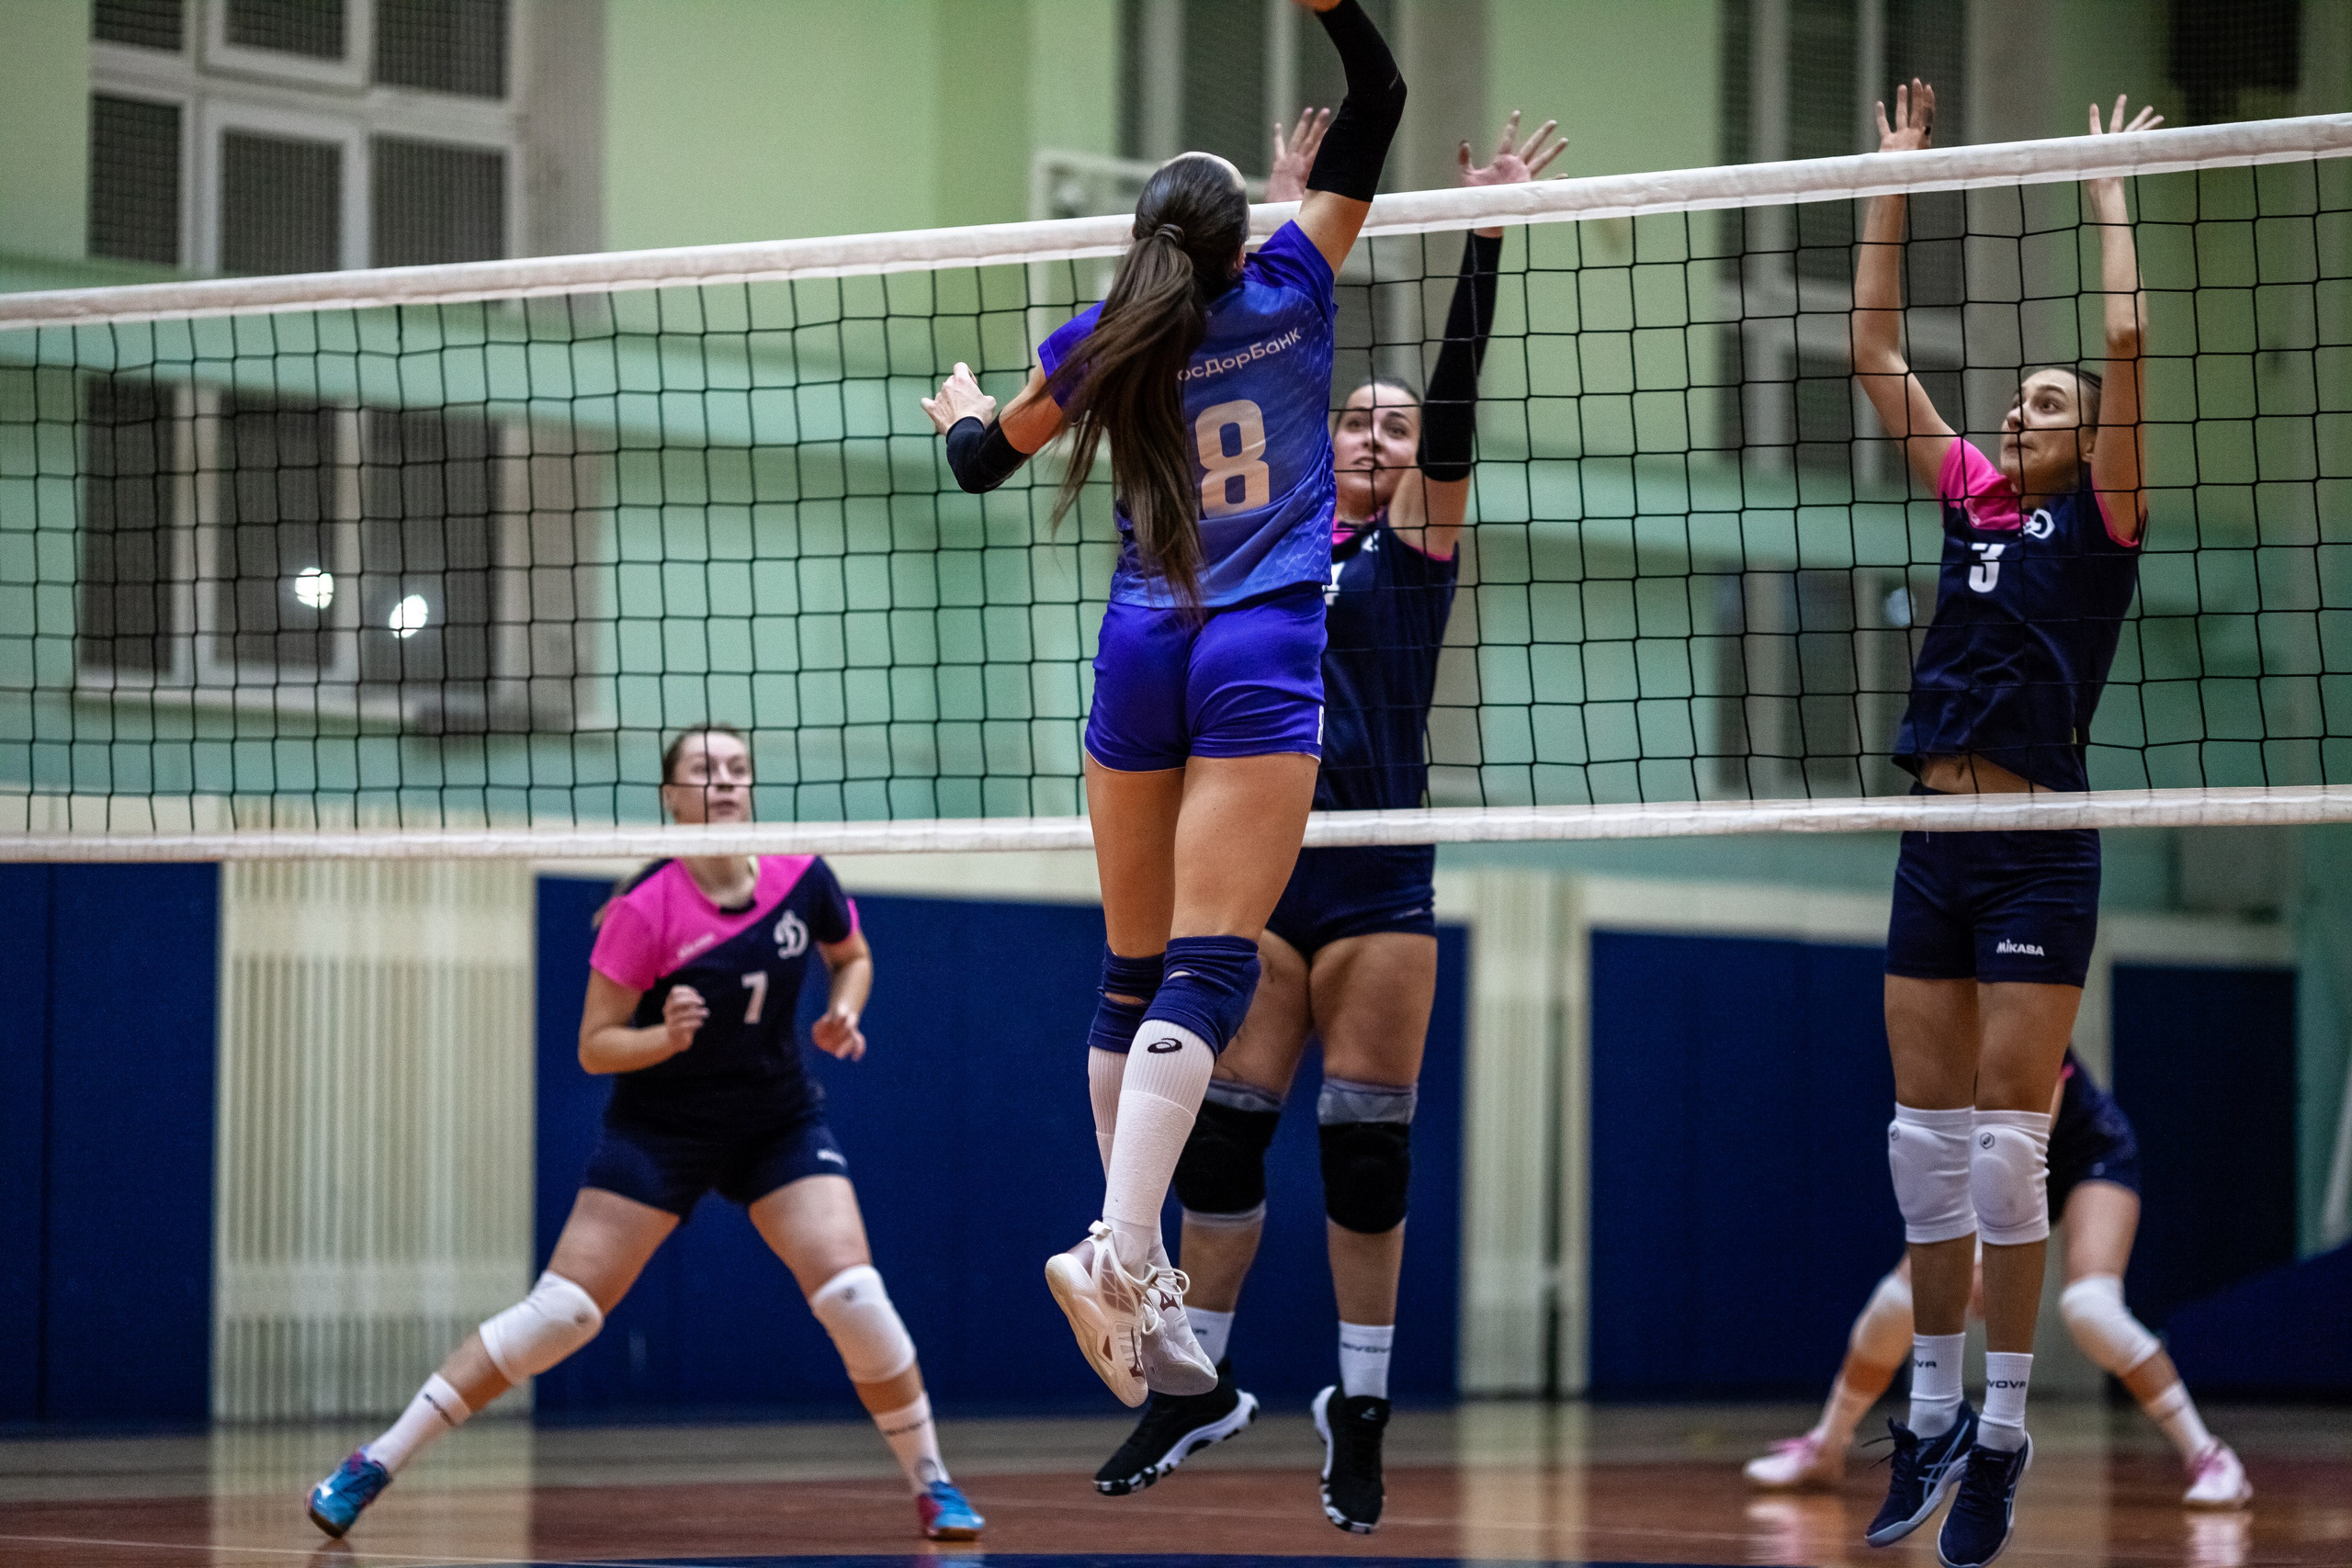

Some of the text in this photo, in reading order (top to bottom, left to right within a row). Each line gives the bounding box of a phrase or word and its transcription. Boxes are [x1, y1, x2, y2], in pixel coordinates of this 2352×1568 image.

[1177, 328, 1302, 381] осДорБанк
[1195, 399, 1270, 520] 8
[1968, 543, 2007, 593] 3
[741, 970, 770, 1025] 7
